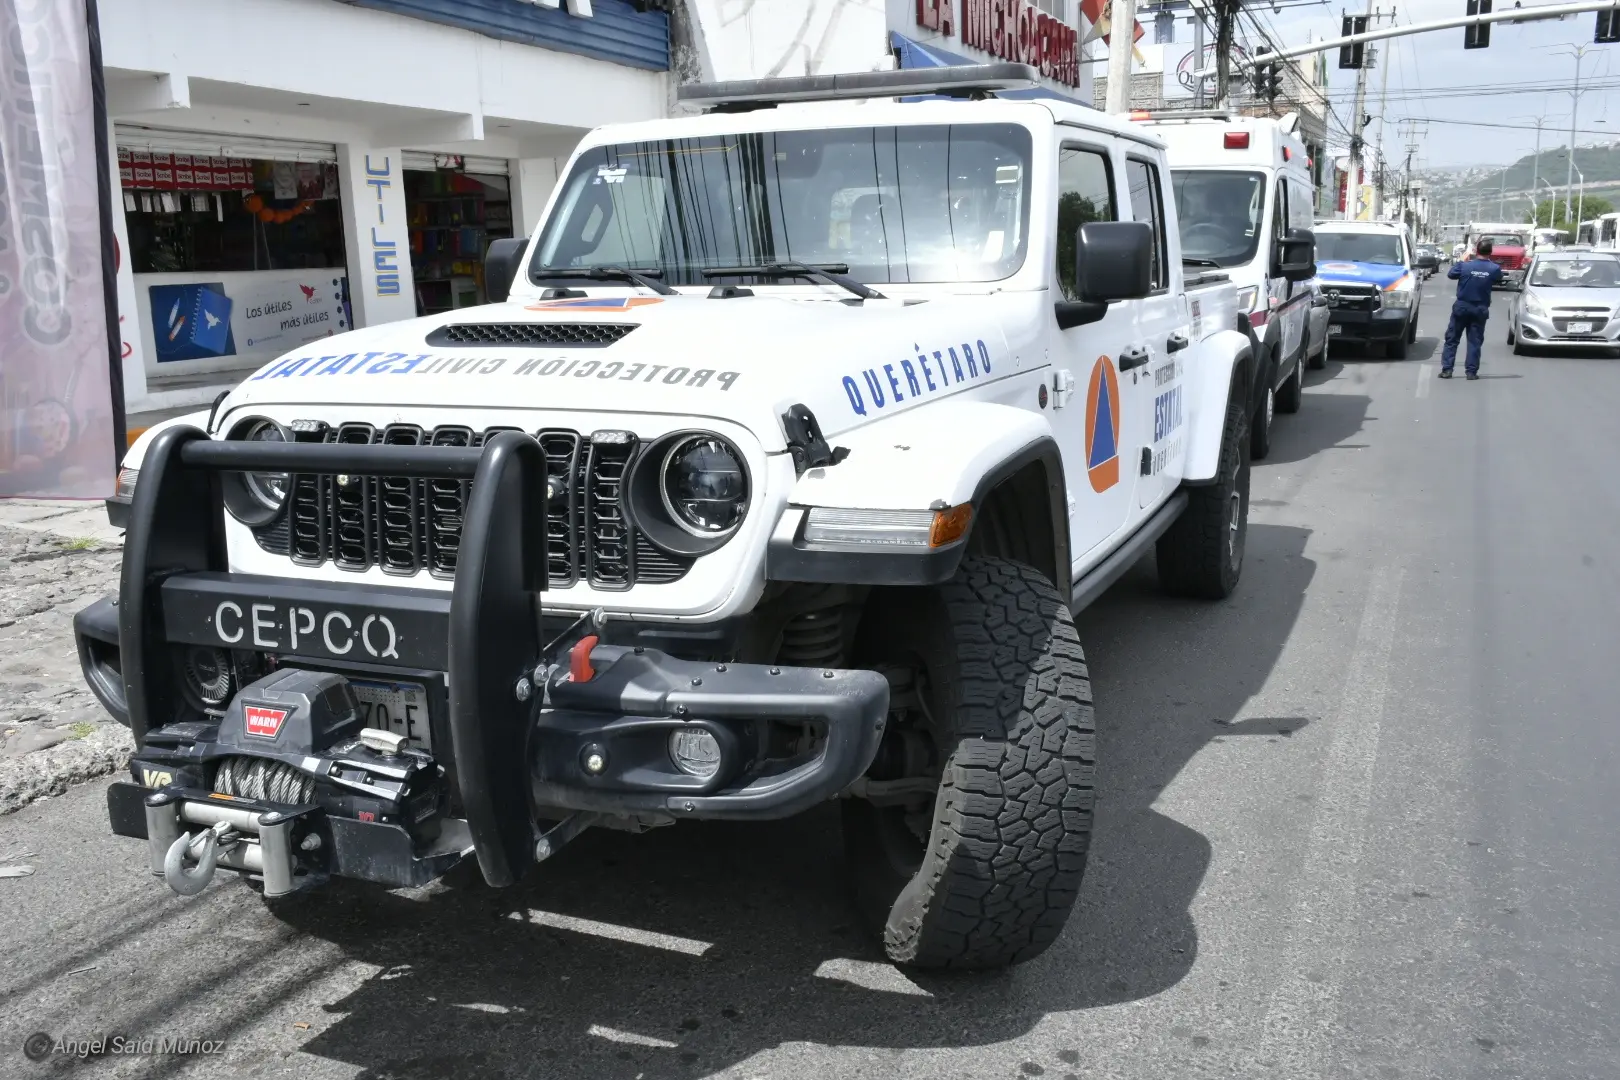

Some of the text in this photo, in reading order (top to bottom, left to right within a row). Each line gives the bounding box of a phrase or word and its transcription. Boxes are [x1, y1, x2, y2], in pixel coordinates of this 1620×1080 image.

[961, 0, 1081, 88] MICHOACANA
[176, 155, 190, 163] Scribe
[136, 170, 152, 178] Scribe
[156, 171, 171, 179] Scribe
[178, 173, 192, 181] Scribe
[196, 174, 210, 182] Scribe
[364, 154, 401, 296] UTILES
[246, 307, 262, 319] Los
[264, 300, 293, 315] útiles
[280, 311, 329, 330] más útiles
[842, 339, 991, 417] QUERÉTARO
[1154, 384, 1183, 443] ESTATAL
[215, 600, 399, 660] CEPCQ
[250, 715, 278, 729] WARN
